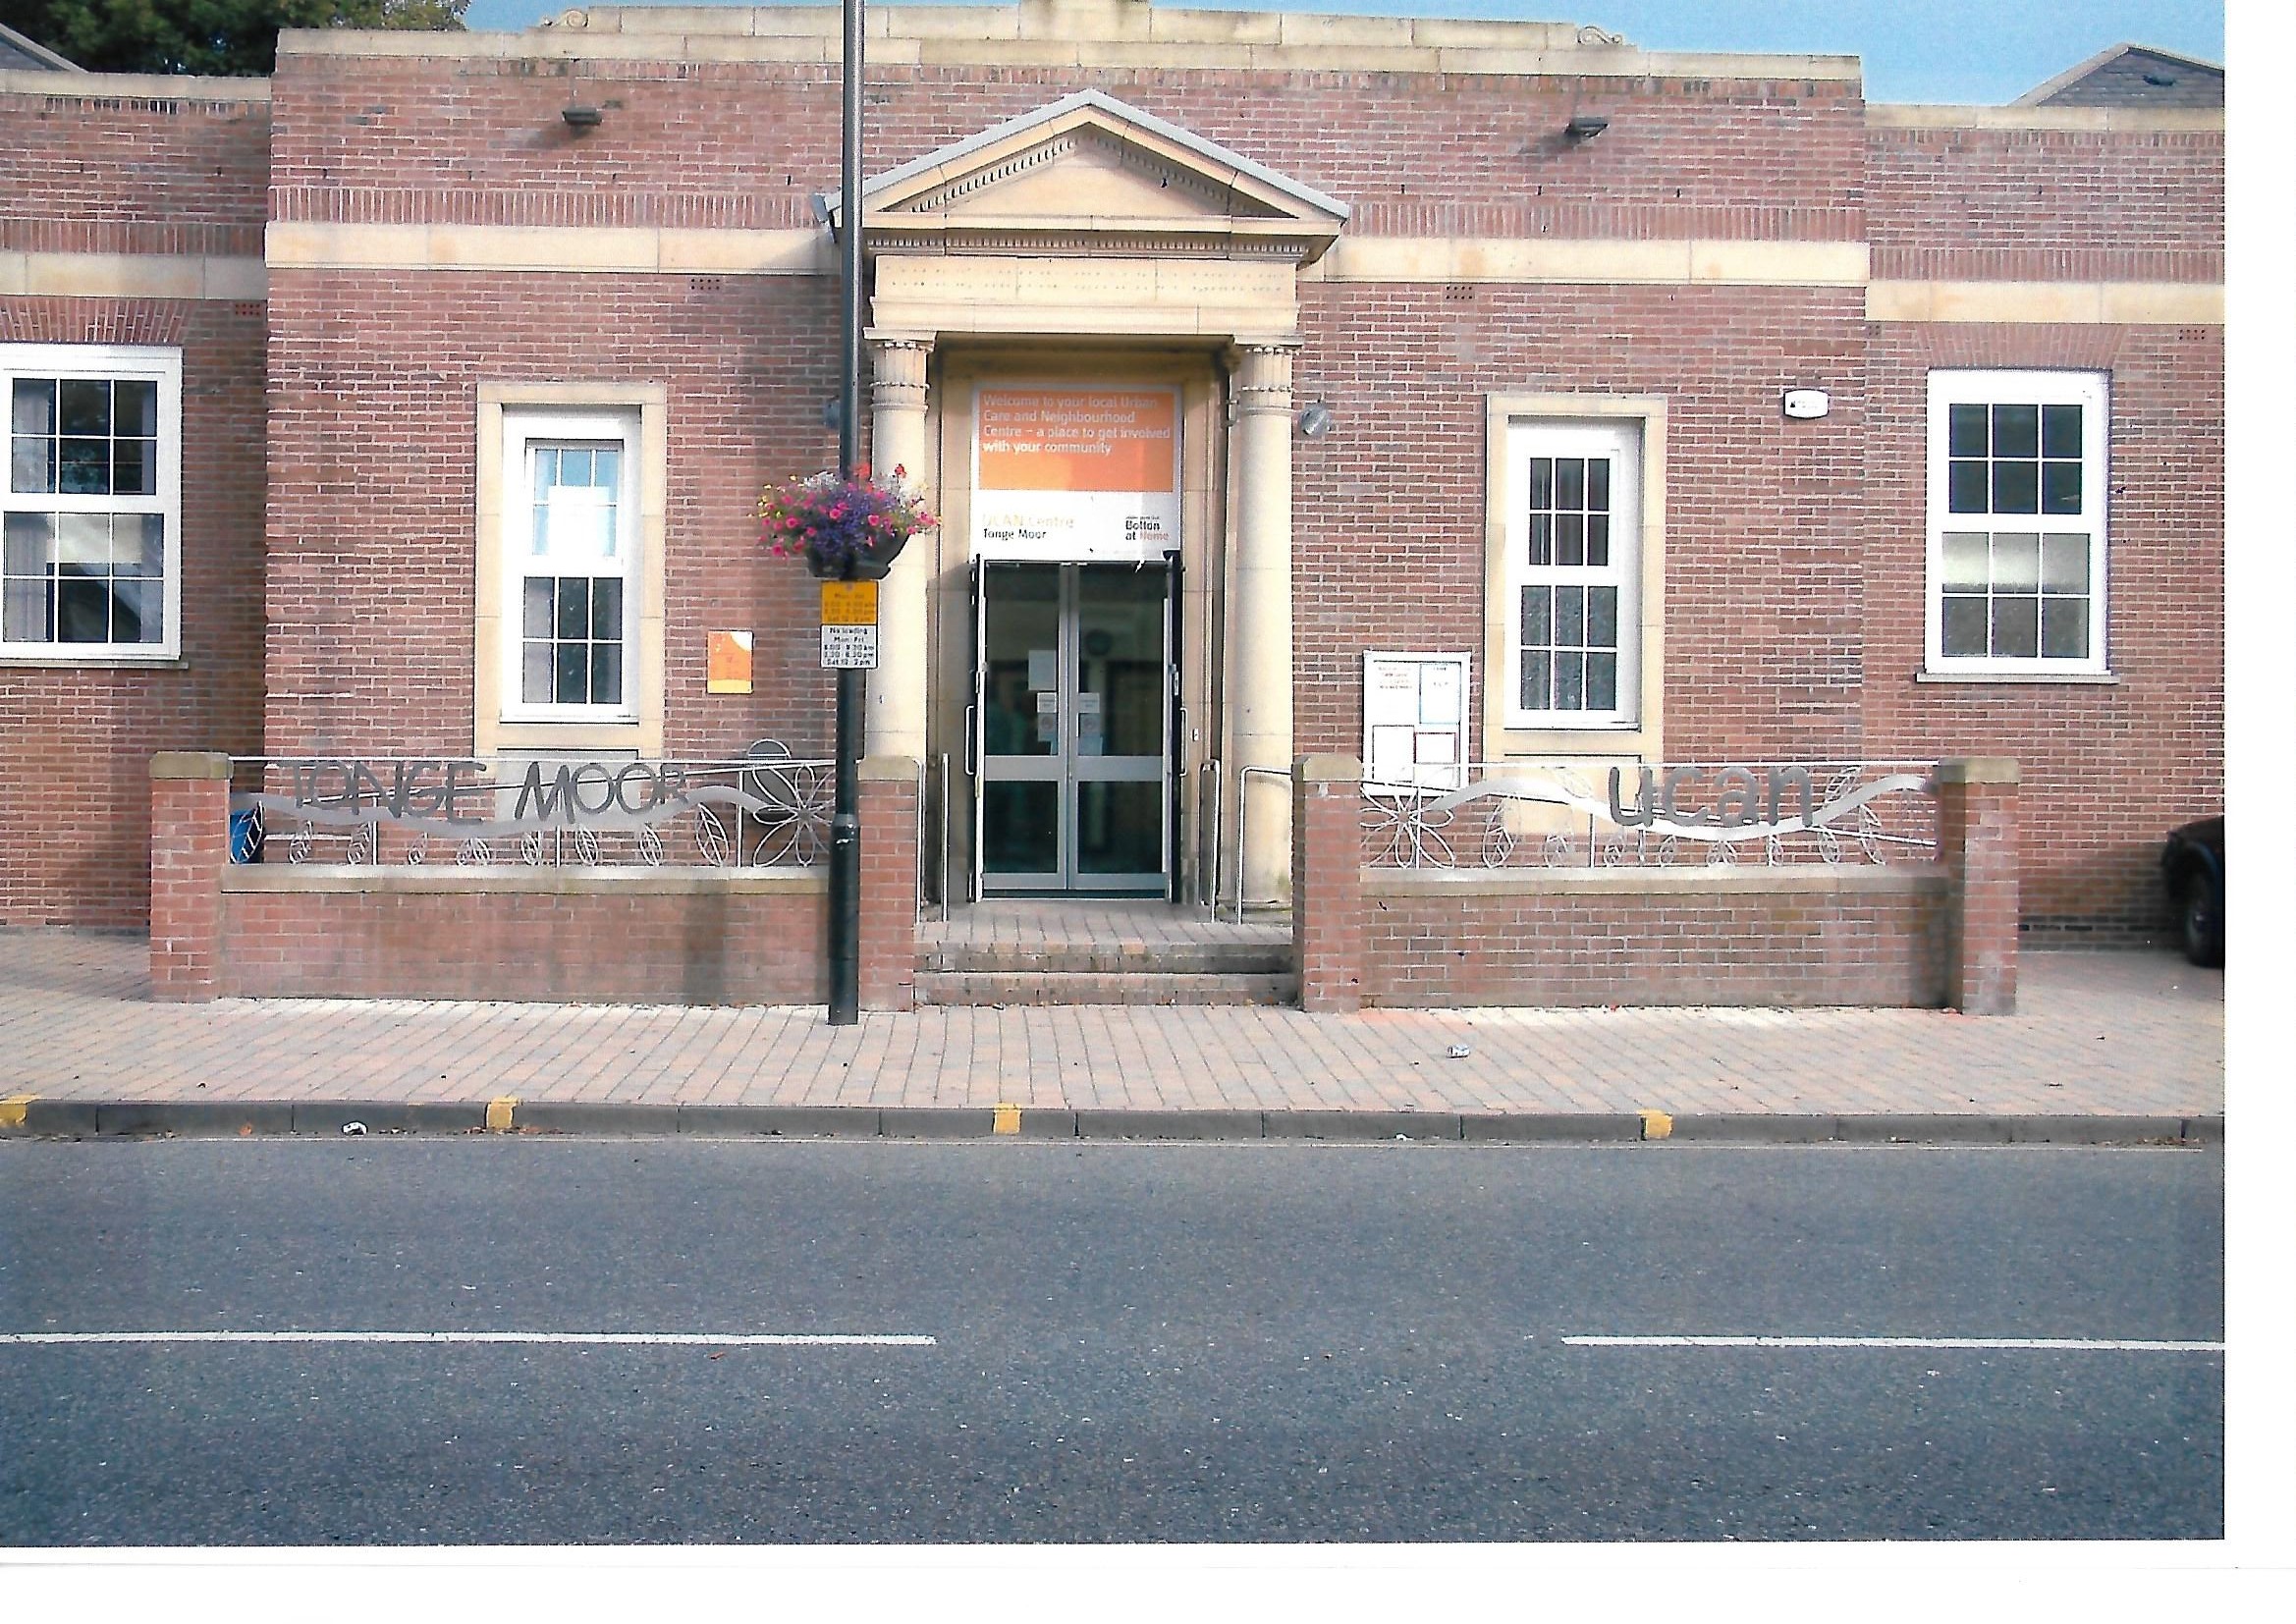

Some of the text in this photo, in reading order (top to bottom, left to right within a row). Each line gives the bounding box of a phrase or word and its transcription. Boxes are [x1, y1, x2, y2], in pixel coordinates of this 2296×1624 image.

[983, 395, 1158, 410] Welcome to your local Urban
[984, 409, 1135, 425] Care and Neighbourhood
[984, 424, 1021, 437] Centre
[1036, 428, 1044, 437] a
[1048, 425, 1078, 441] place
[1082, 427, 1094, 438] to
[1098, 426, 1118, 441] get
[1121, 426, 1171, 439] involved
[983, 440, 1112, 456] with your community
[1125, 519, 1161, 530] Bolton
[983, 528, 1047, 540] Tonge Moor
[1125, 531, 1170, 541] at Home
[277, 760, 688, 826] TONGE MOOR
[1608, 766, 1814, 828] ucan
